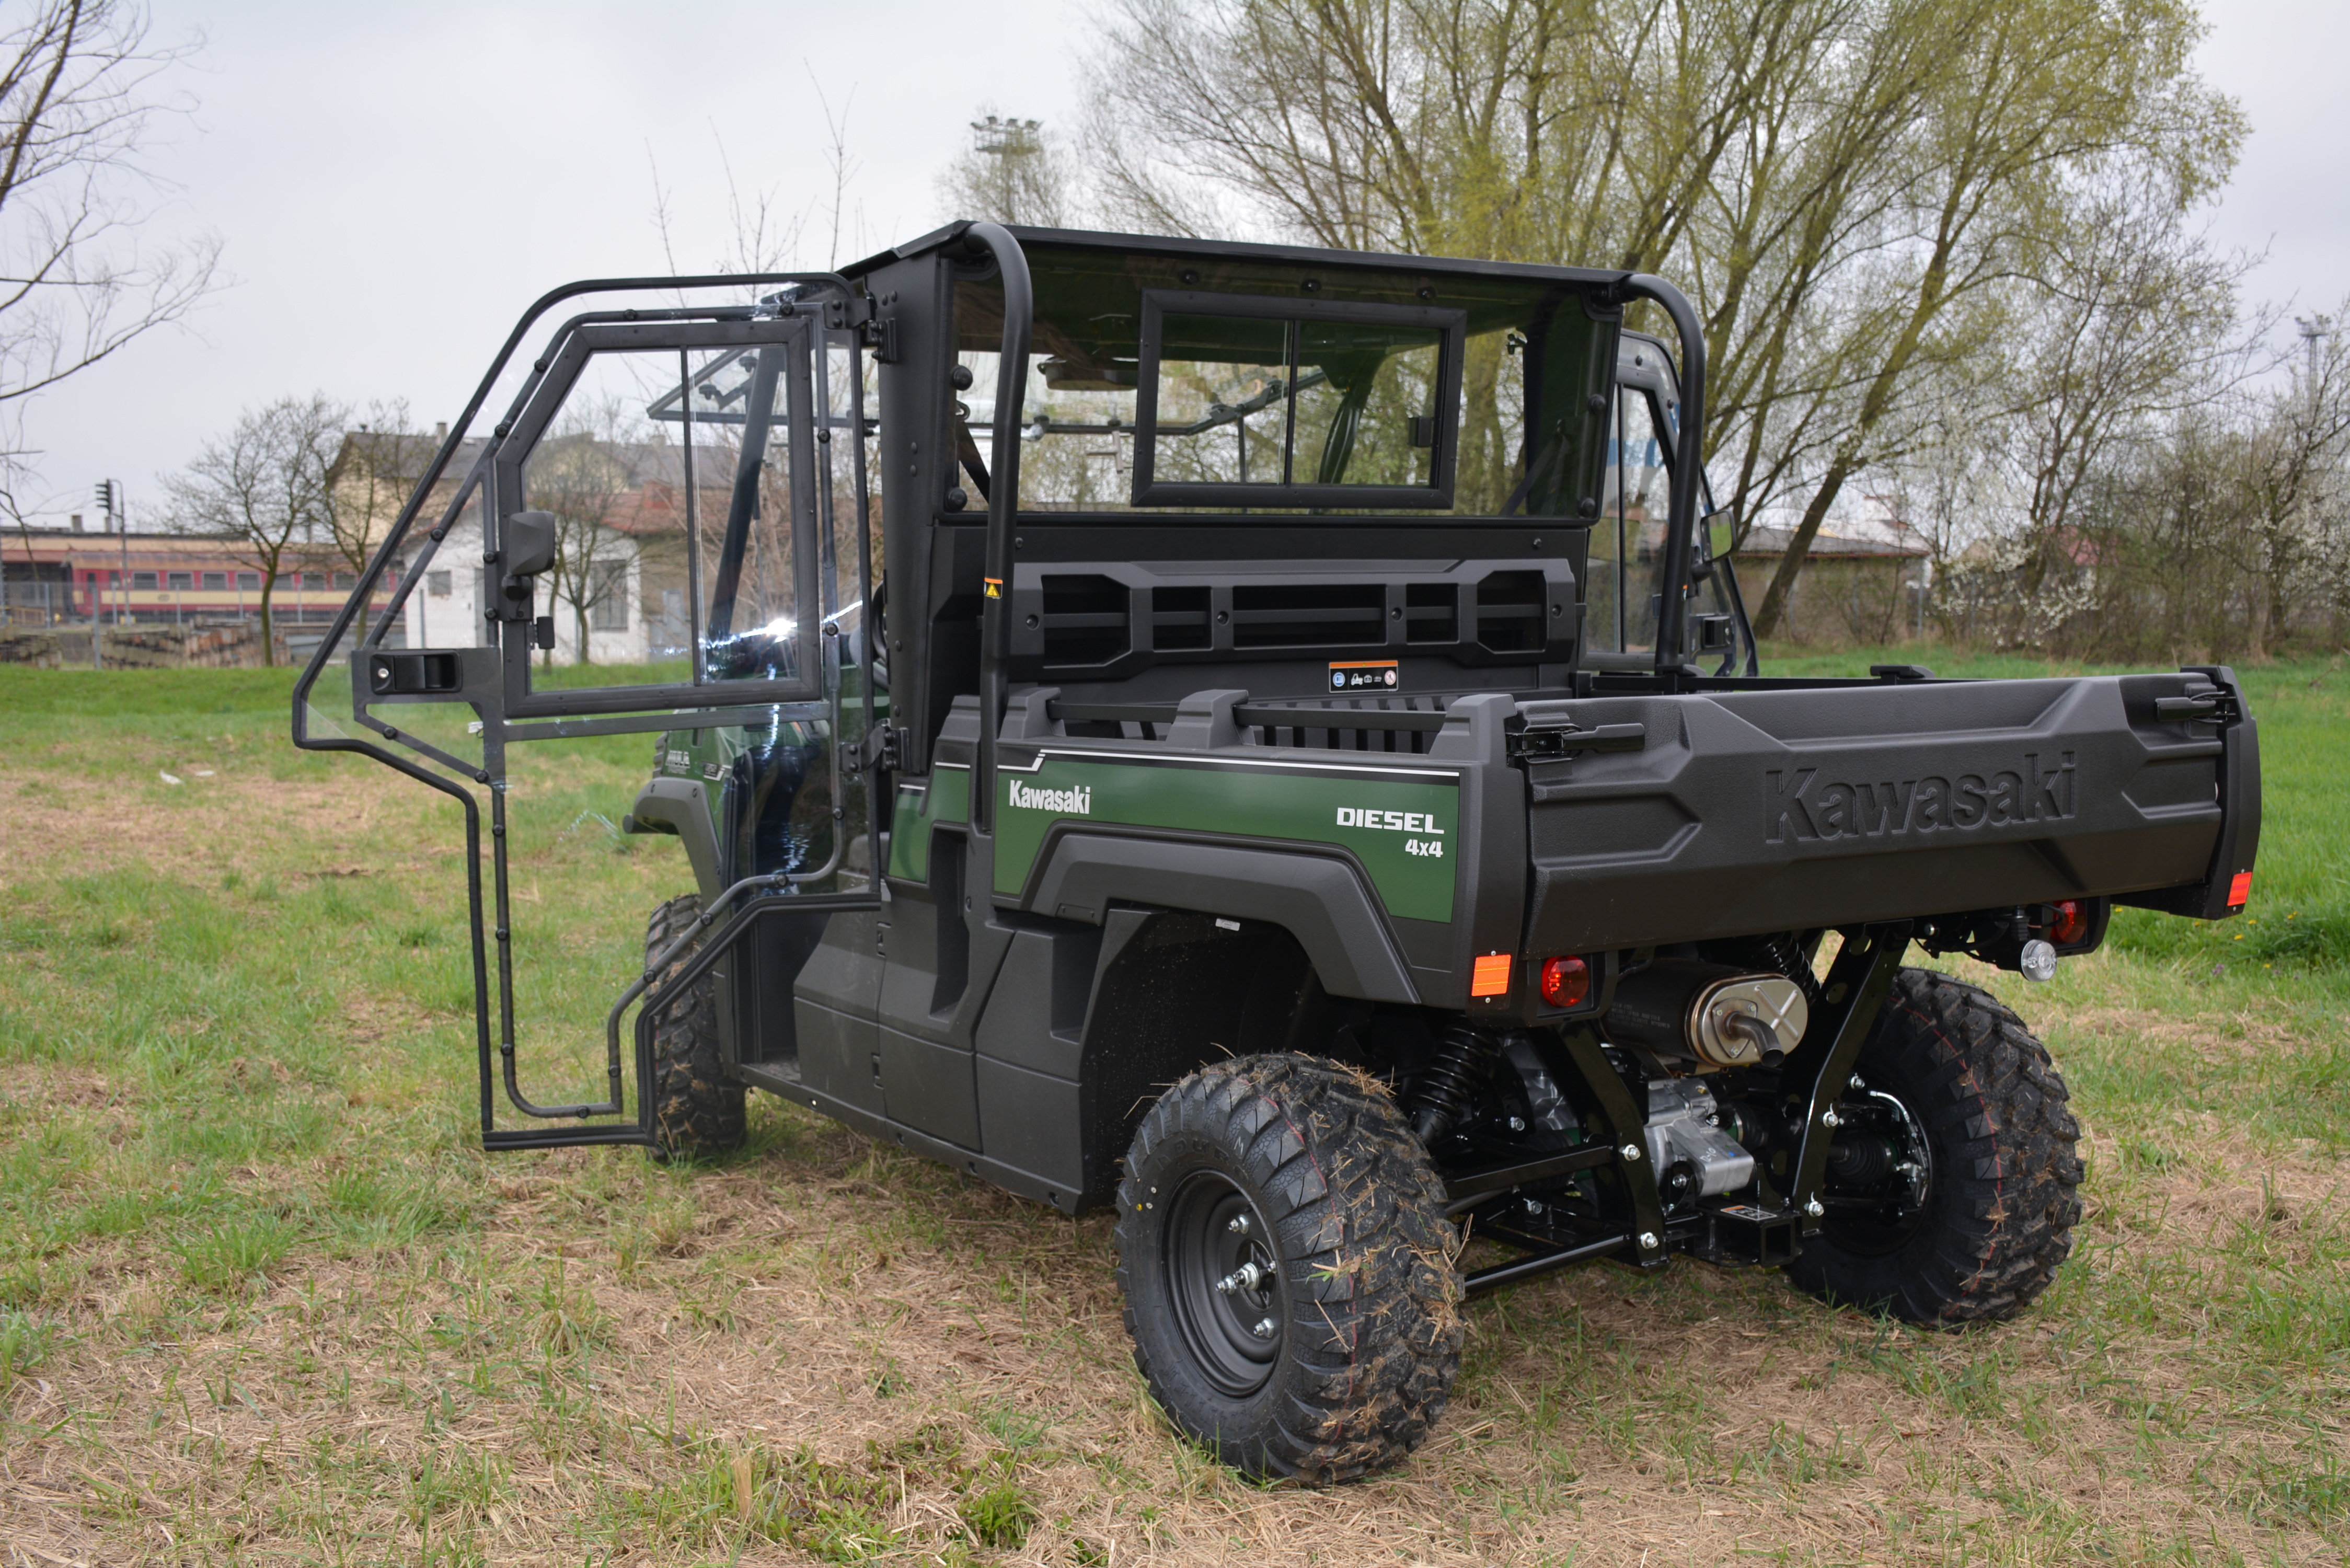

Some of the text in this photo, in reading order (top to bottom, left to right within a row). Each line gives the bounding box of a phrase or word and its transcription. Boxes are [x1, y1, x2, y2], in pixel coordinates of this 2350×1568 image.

[1009, 779, 1091, 814] Kawasaki
[1766, 751, 2076, 844] Kawasaki
[1337, 807, 1445, 834] DIESEL
[1405, 839, 1443, 858] 4x4
